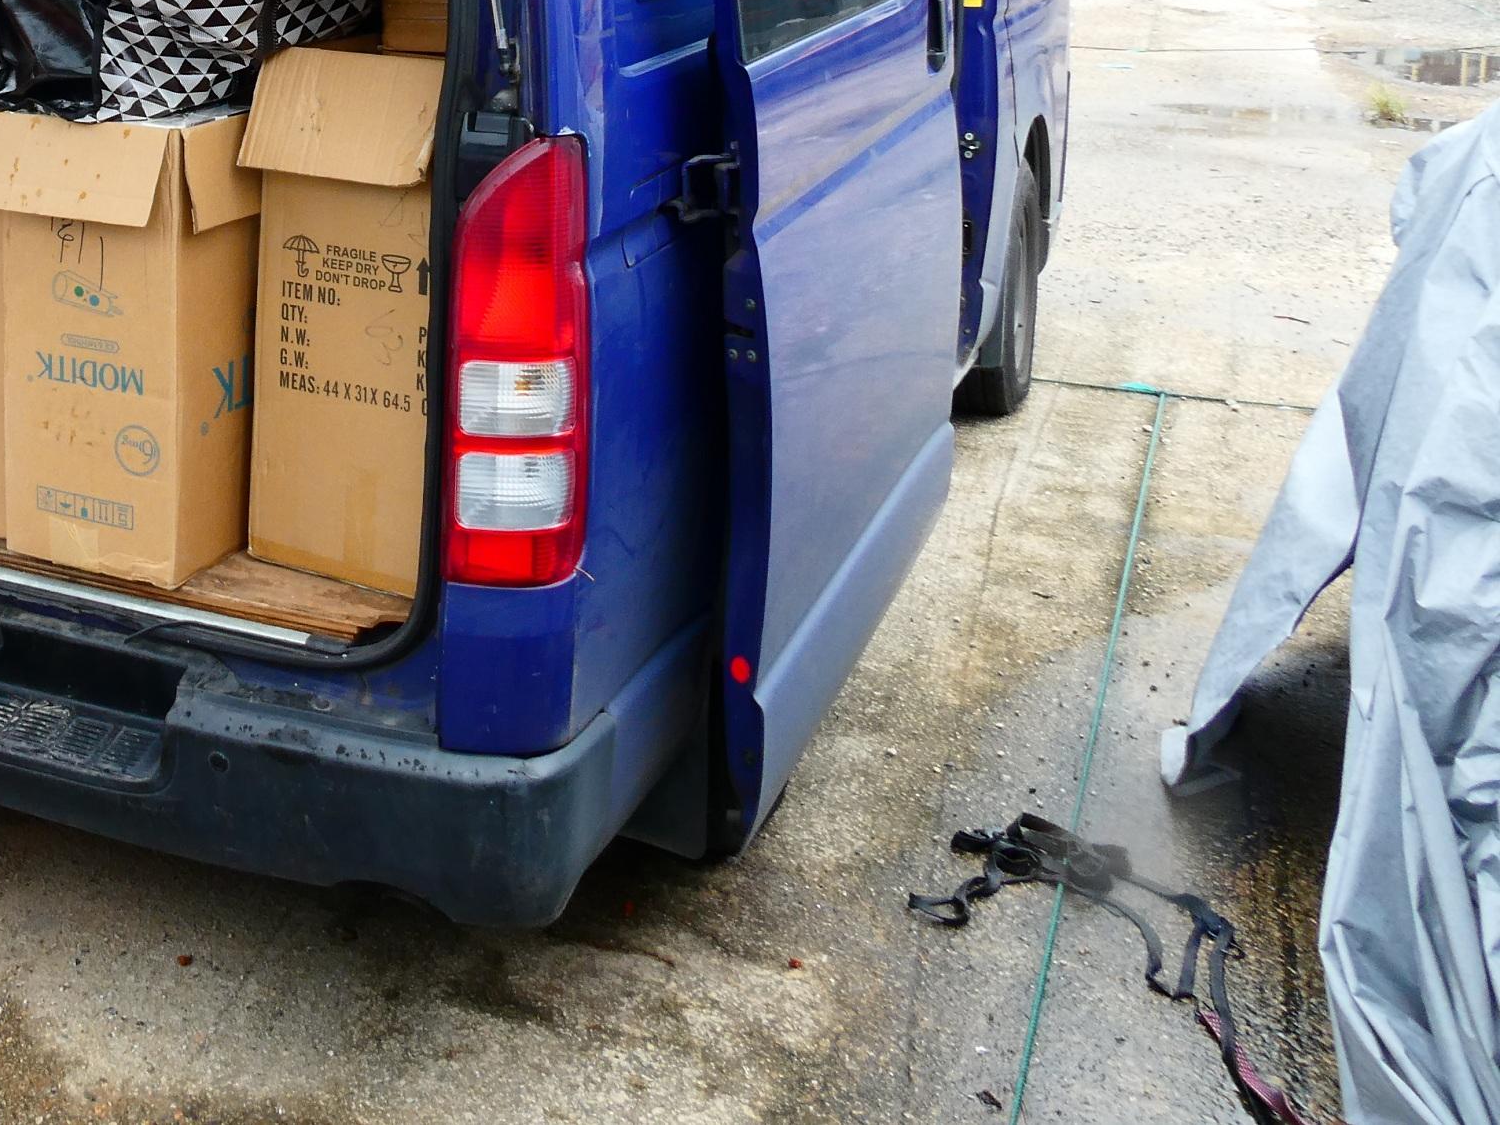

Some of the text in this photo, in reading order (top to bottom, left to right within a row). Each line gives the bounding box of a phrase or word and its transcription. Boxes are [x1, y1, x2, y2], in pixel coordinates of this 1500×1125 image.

[326, 245, 377, 262] FRAGILE
[322, 258, 379, 275] KEEP DRY
[316, 271, 386, 290] DON'T DROP
[282, 281, 340, 306] ITEM NO:
[282, 303, 307, 323] QTY:
[281, 326, 310, 346] N.W:
[280, 348, 308, 369] G.W:
[36, 351, 144, 395] MODITK
[280, 371, 320, 394] MEAS:
[323, 380, 338, 398] 44
[383, 392, 411, 412] 64.5
